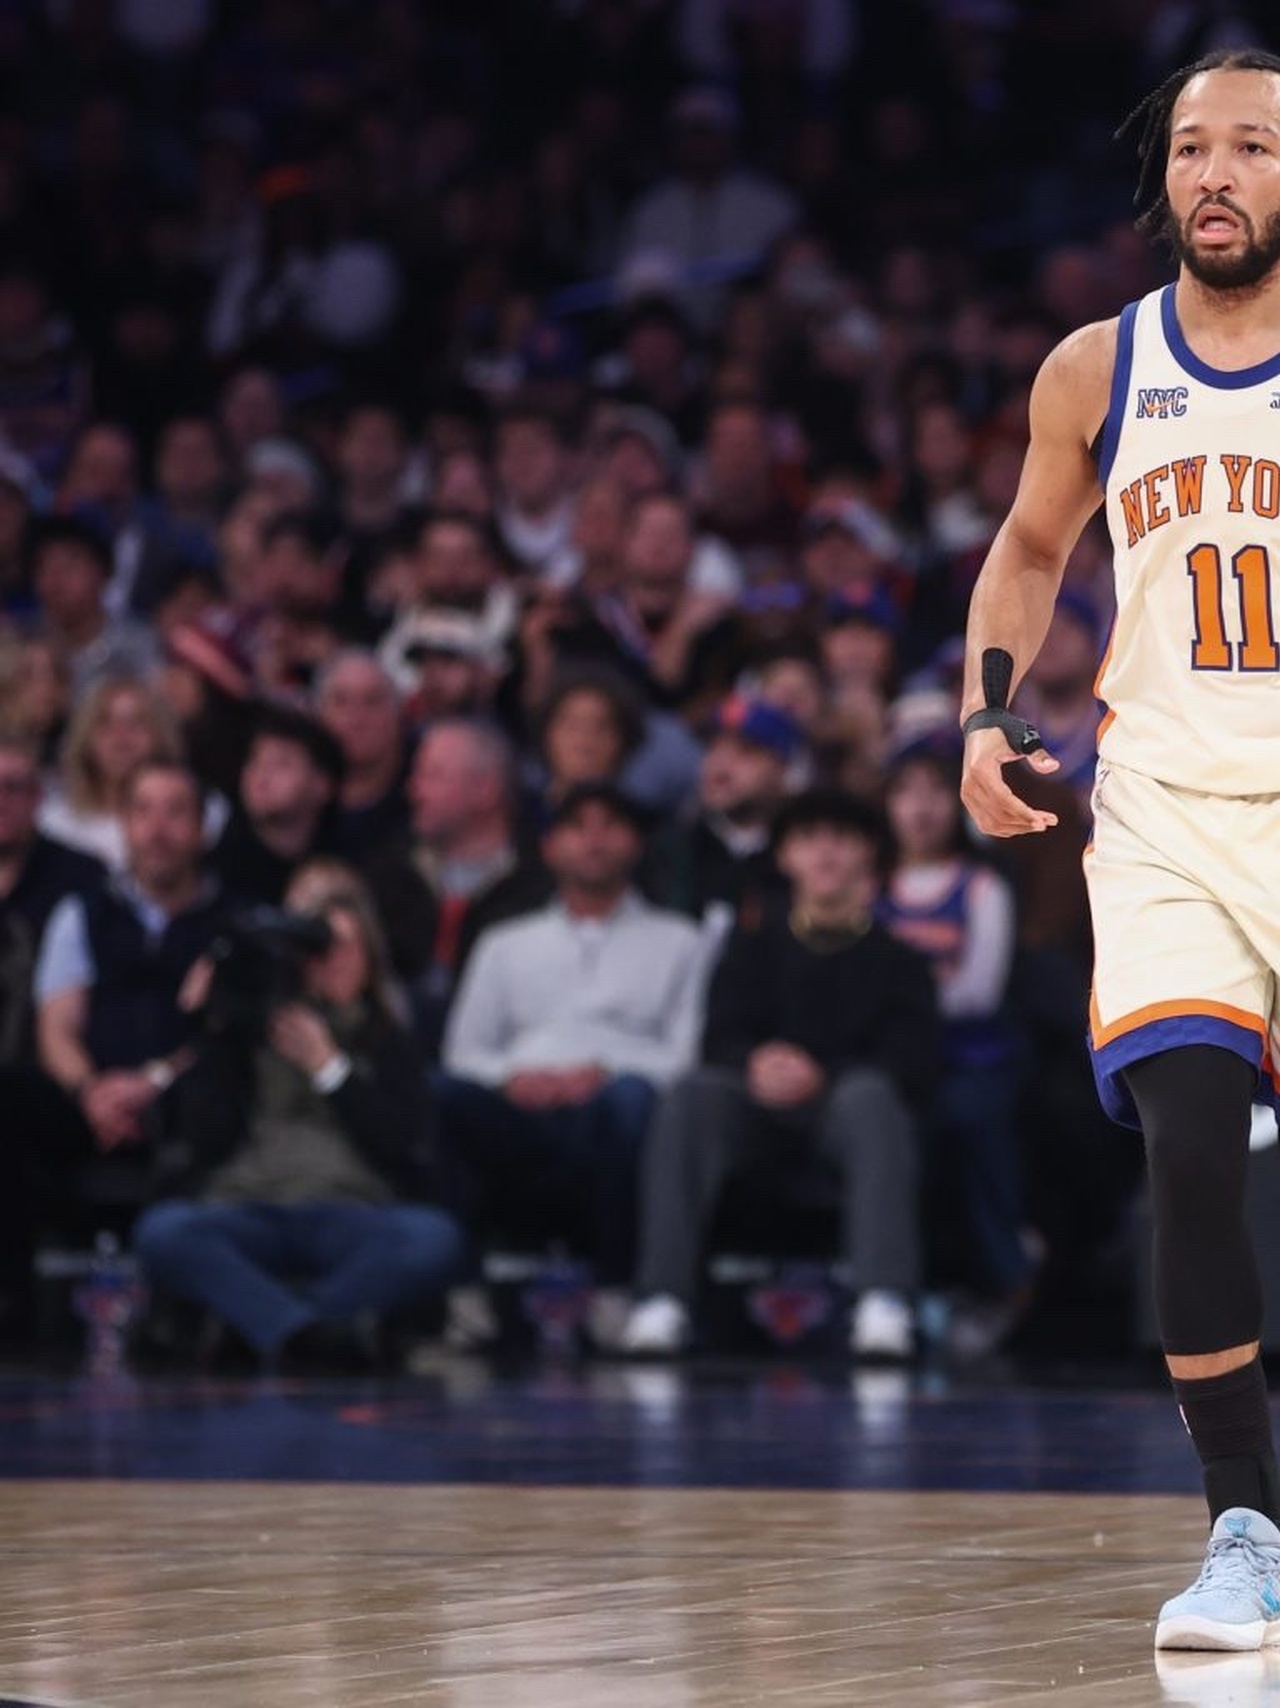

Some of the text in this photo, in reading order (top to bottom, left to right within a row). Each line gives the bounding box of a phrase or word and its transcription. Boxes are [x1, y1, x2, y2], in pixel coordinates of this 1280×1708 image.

[1136, 386, 1188, 419] NYC
[1120, 455, 1207, 549] NEW
[1186, 543, 1280, 672] 11
